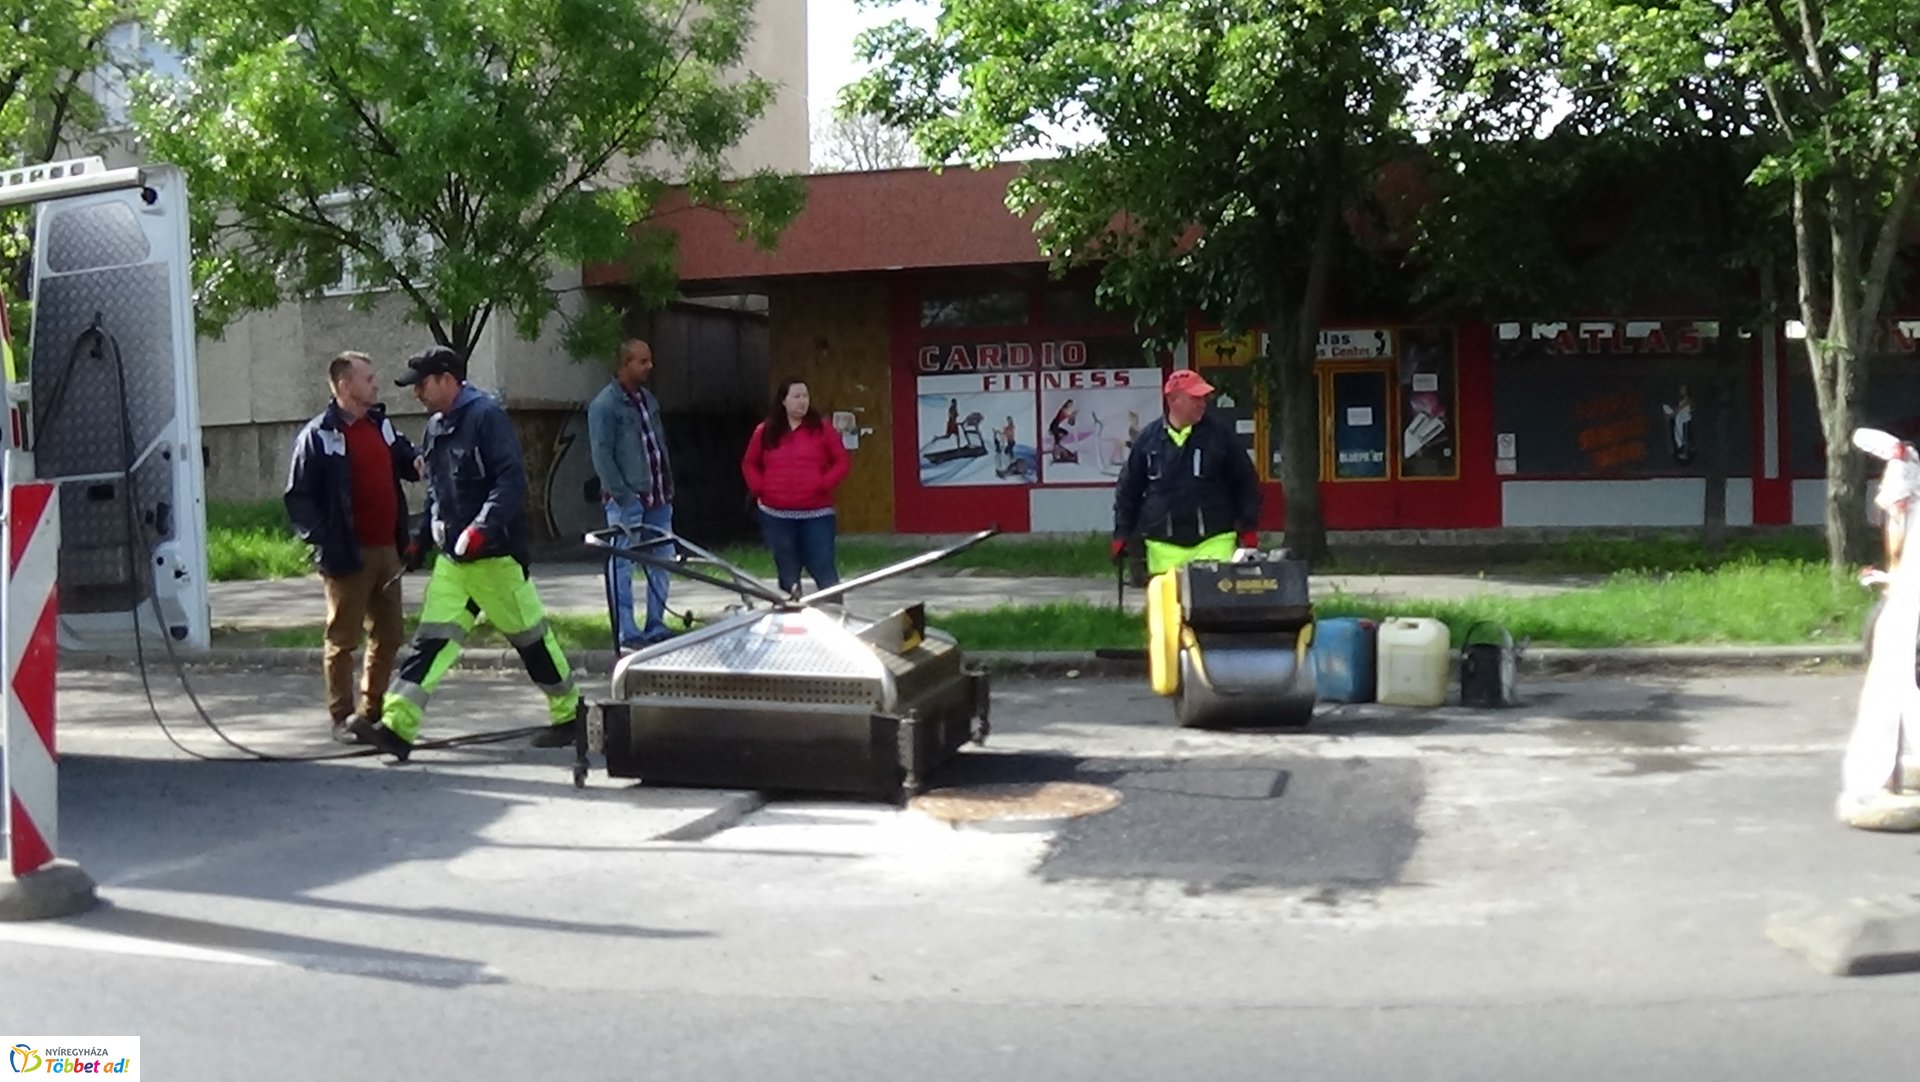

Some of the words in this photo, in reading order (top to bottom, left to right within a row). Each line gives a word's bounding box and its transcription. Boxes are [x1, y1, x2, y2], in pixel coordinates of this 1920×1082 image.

[1546, 327, 1703, 354] ATLAS
[919, 340, 1087, 371] CARDIO
[982, 370, 1131, 392] FITNESS
